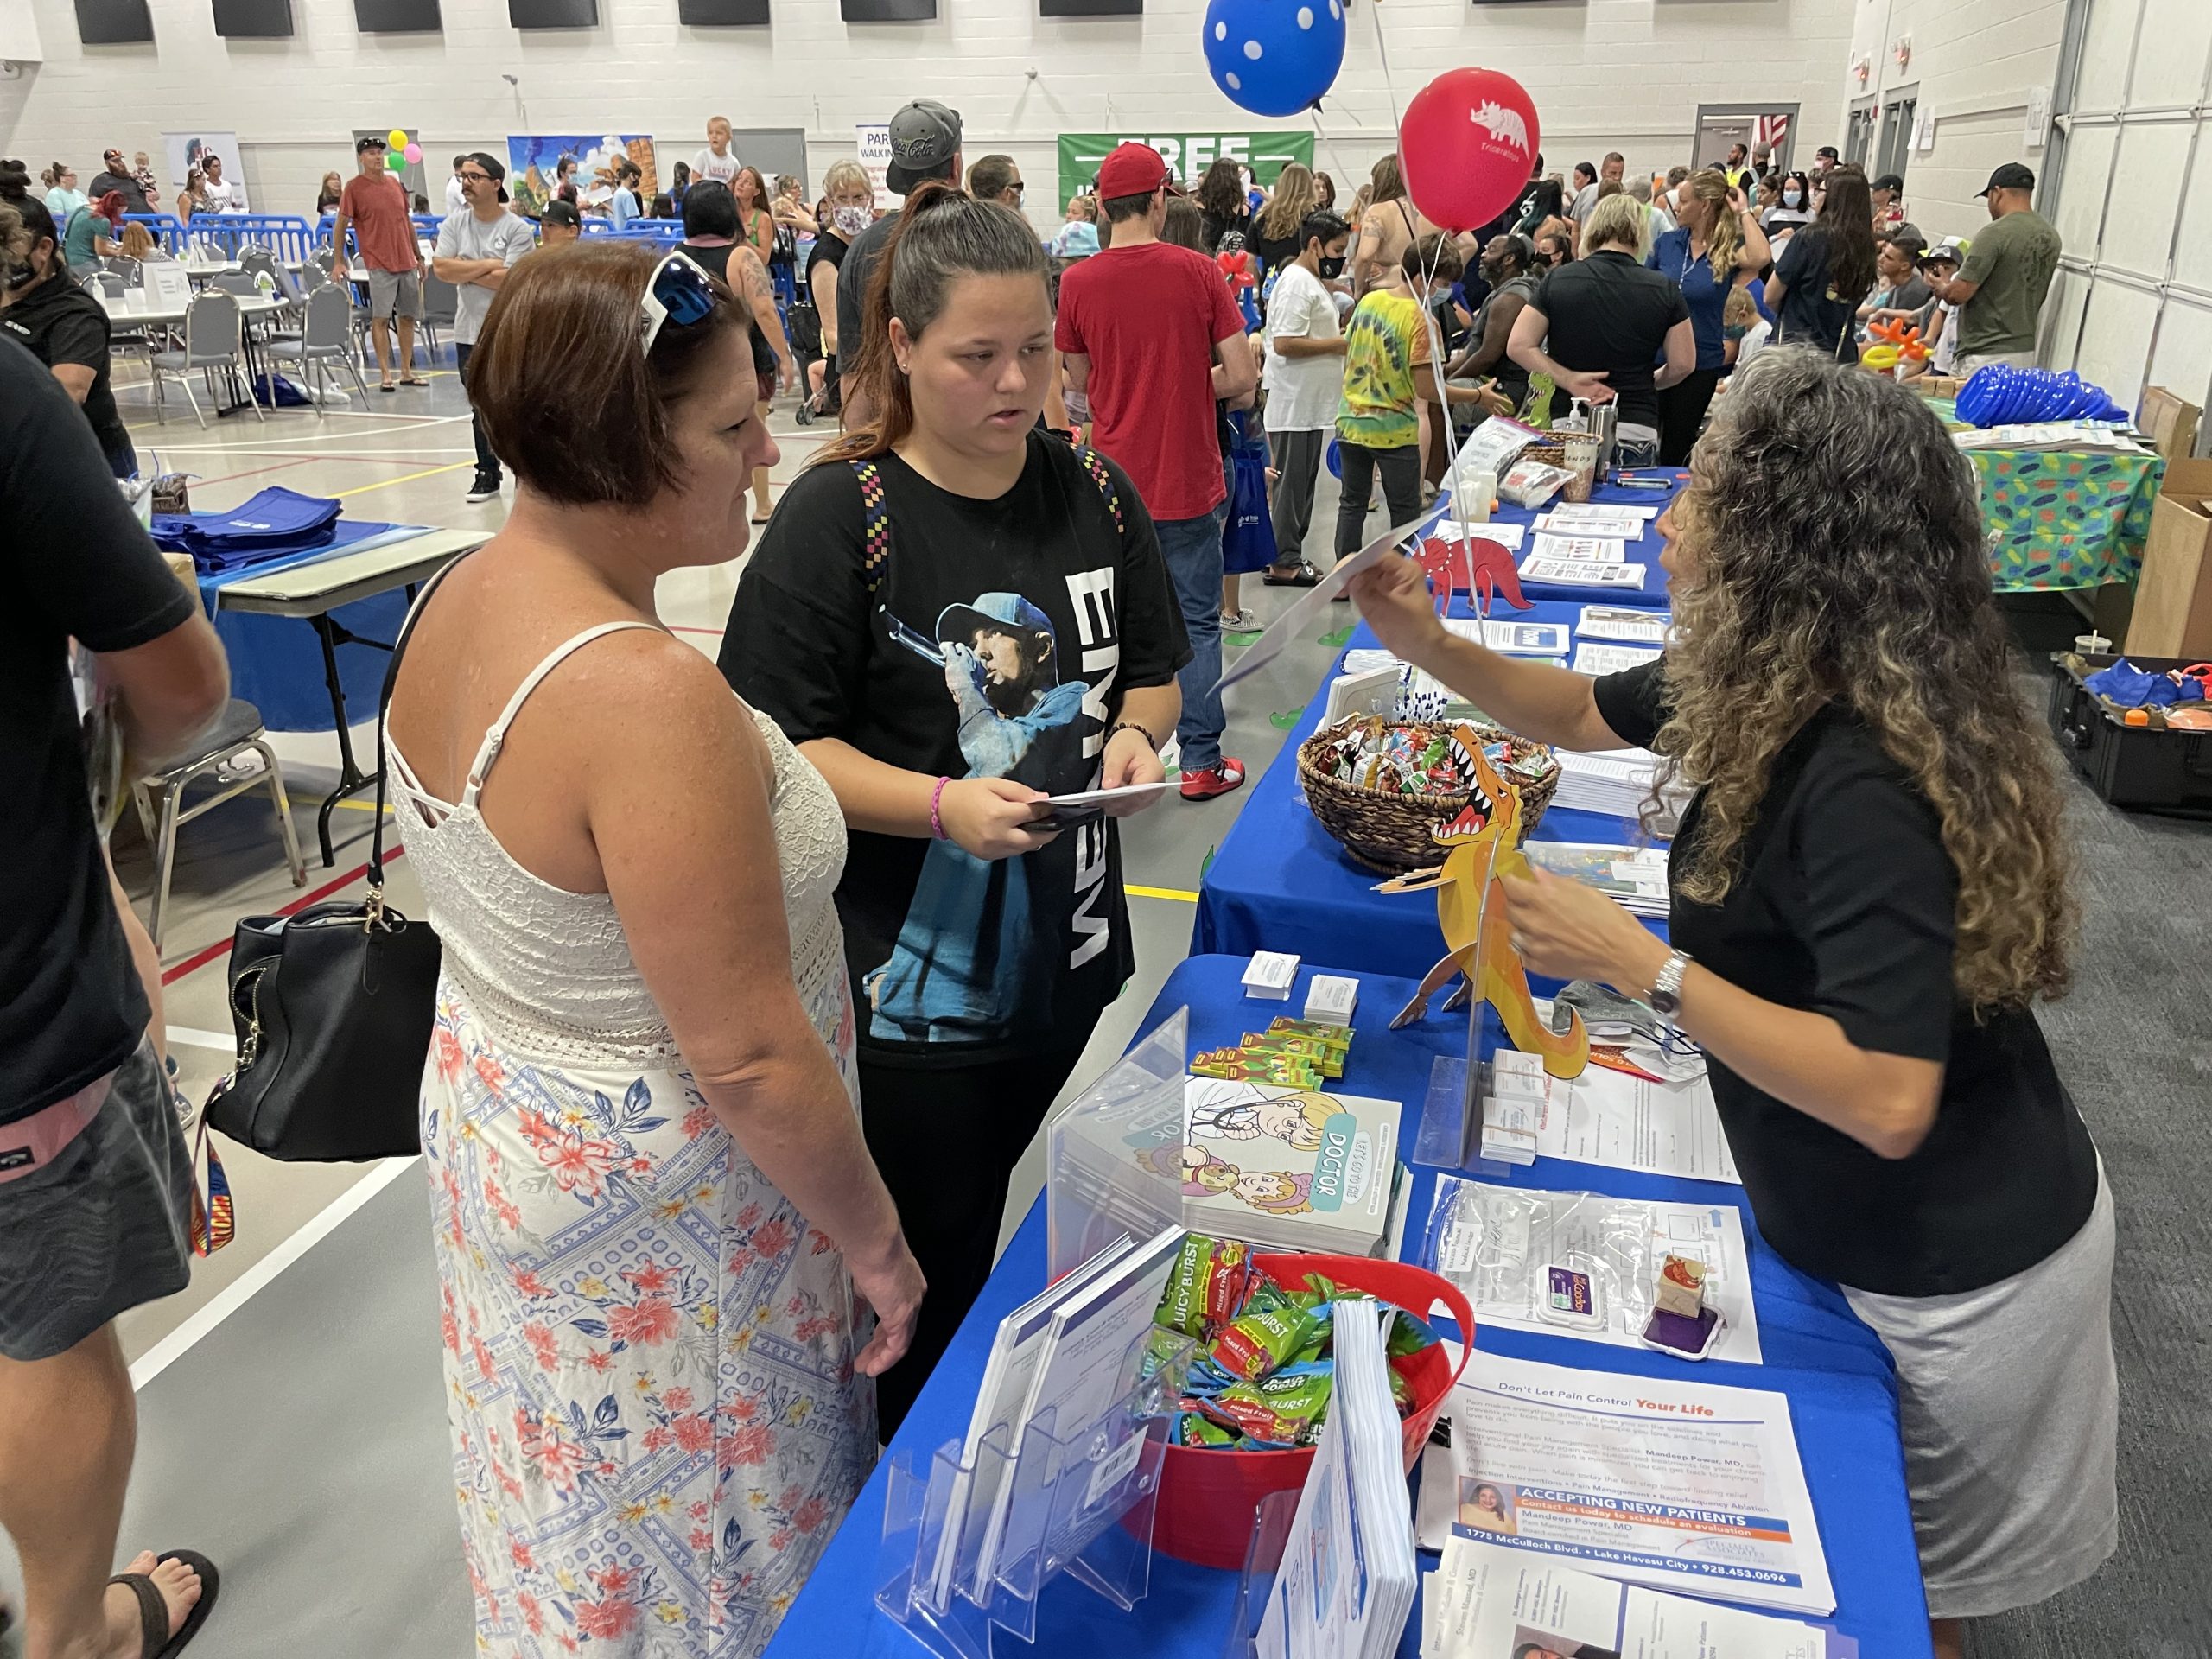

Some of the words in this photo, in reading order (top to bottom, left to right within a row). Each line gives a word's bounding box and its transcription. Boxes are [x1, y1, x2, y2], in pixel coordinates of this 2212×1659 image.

[861, 149, 883, 158] WALK
[1117, 137, 1250, 181] REE
[1314, 1132, 1347, 1197] DOCTOR
[1181, 1240, 1199, 1287] BURST
[1217, 1289, 1226, 1313] Mixed
[1230, 1404, 1253, 1415] Mixed
[1499, 1382, 1532, 1394] Don't
[1535, 1388, 1554, 1397] Let
[1558, 1390, 1583, 1401] Pain
[1587, 1395, 1631, 1407] Control
[1636, 1399, 1676, 1412] Your
[1681, 1404, 1714, 1417] Life
[1645, 1449, 1688, 1462] Mandeep
[1469, 1467, 1504, 1478] Injection
[1506, 1474, 1563, 1486] Interventions
[1572, 1481, 1591, 1490] Pain
[1592, 1484, 1650, 1498] Management
[1659, 1494, 1729, 1510] Radiofrequency
[1730, 1502, 1770, 1513] Ablation
[1521, 1487, 1617, 1510] ACCEPTING
[1621, 1500, 1663, 1516] NEW
[1667, 1506, 1746, 1527] PATIENTS
[1521, 1499, 1563, 1511] Contact
[1580, 1506, 1611, 1519] today
[1629, 1515, 1676, 1527] schedule
[1695, 1523, 1752, 1537] evaluation
[1522, 1510, 1572, 1523] Mandeep
[1574, 1517, 1611, 1529] Powar,
[1613, 1522, 1632, 1531] MD
[1466, 1529, 1493, 1541] 1775
[1496, 1534, 1551, 1551] McCulloch
[1554, 1542, 1582, 1555] Blvd.
[1594, 1549, 1620, 1560] Lake
[1623, 1554, 1663, 1567] Havasu
[1666, 1560, 1688, 1572] City
[1701, 1564, 1787, 1583] 928.453.0696
[1456, 1611, 1467, 1637] Steven
[1467, 1568, 1478, 1581] MD
